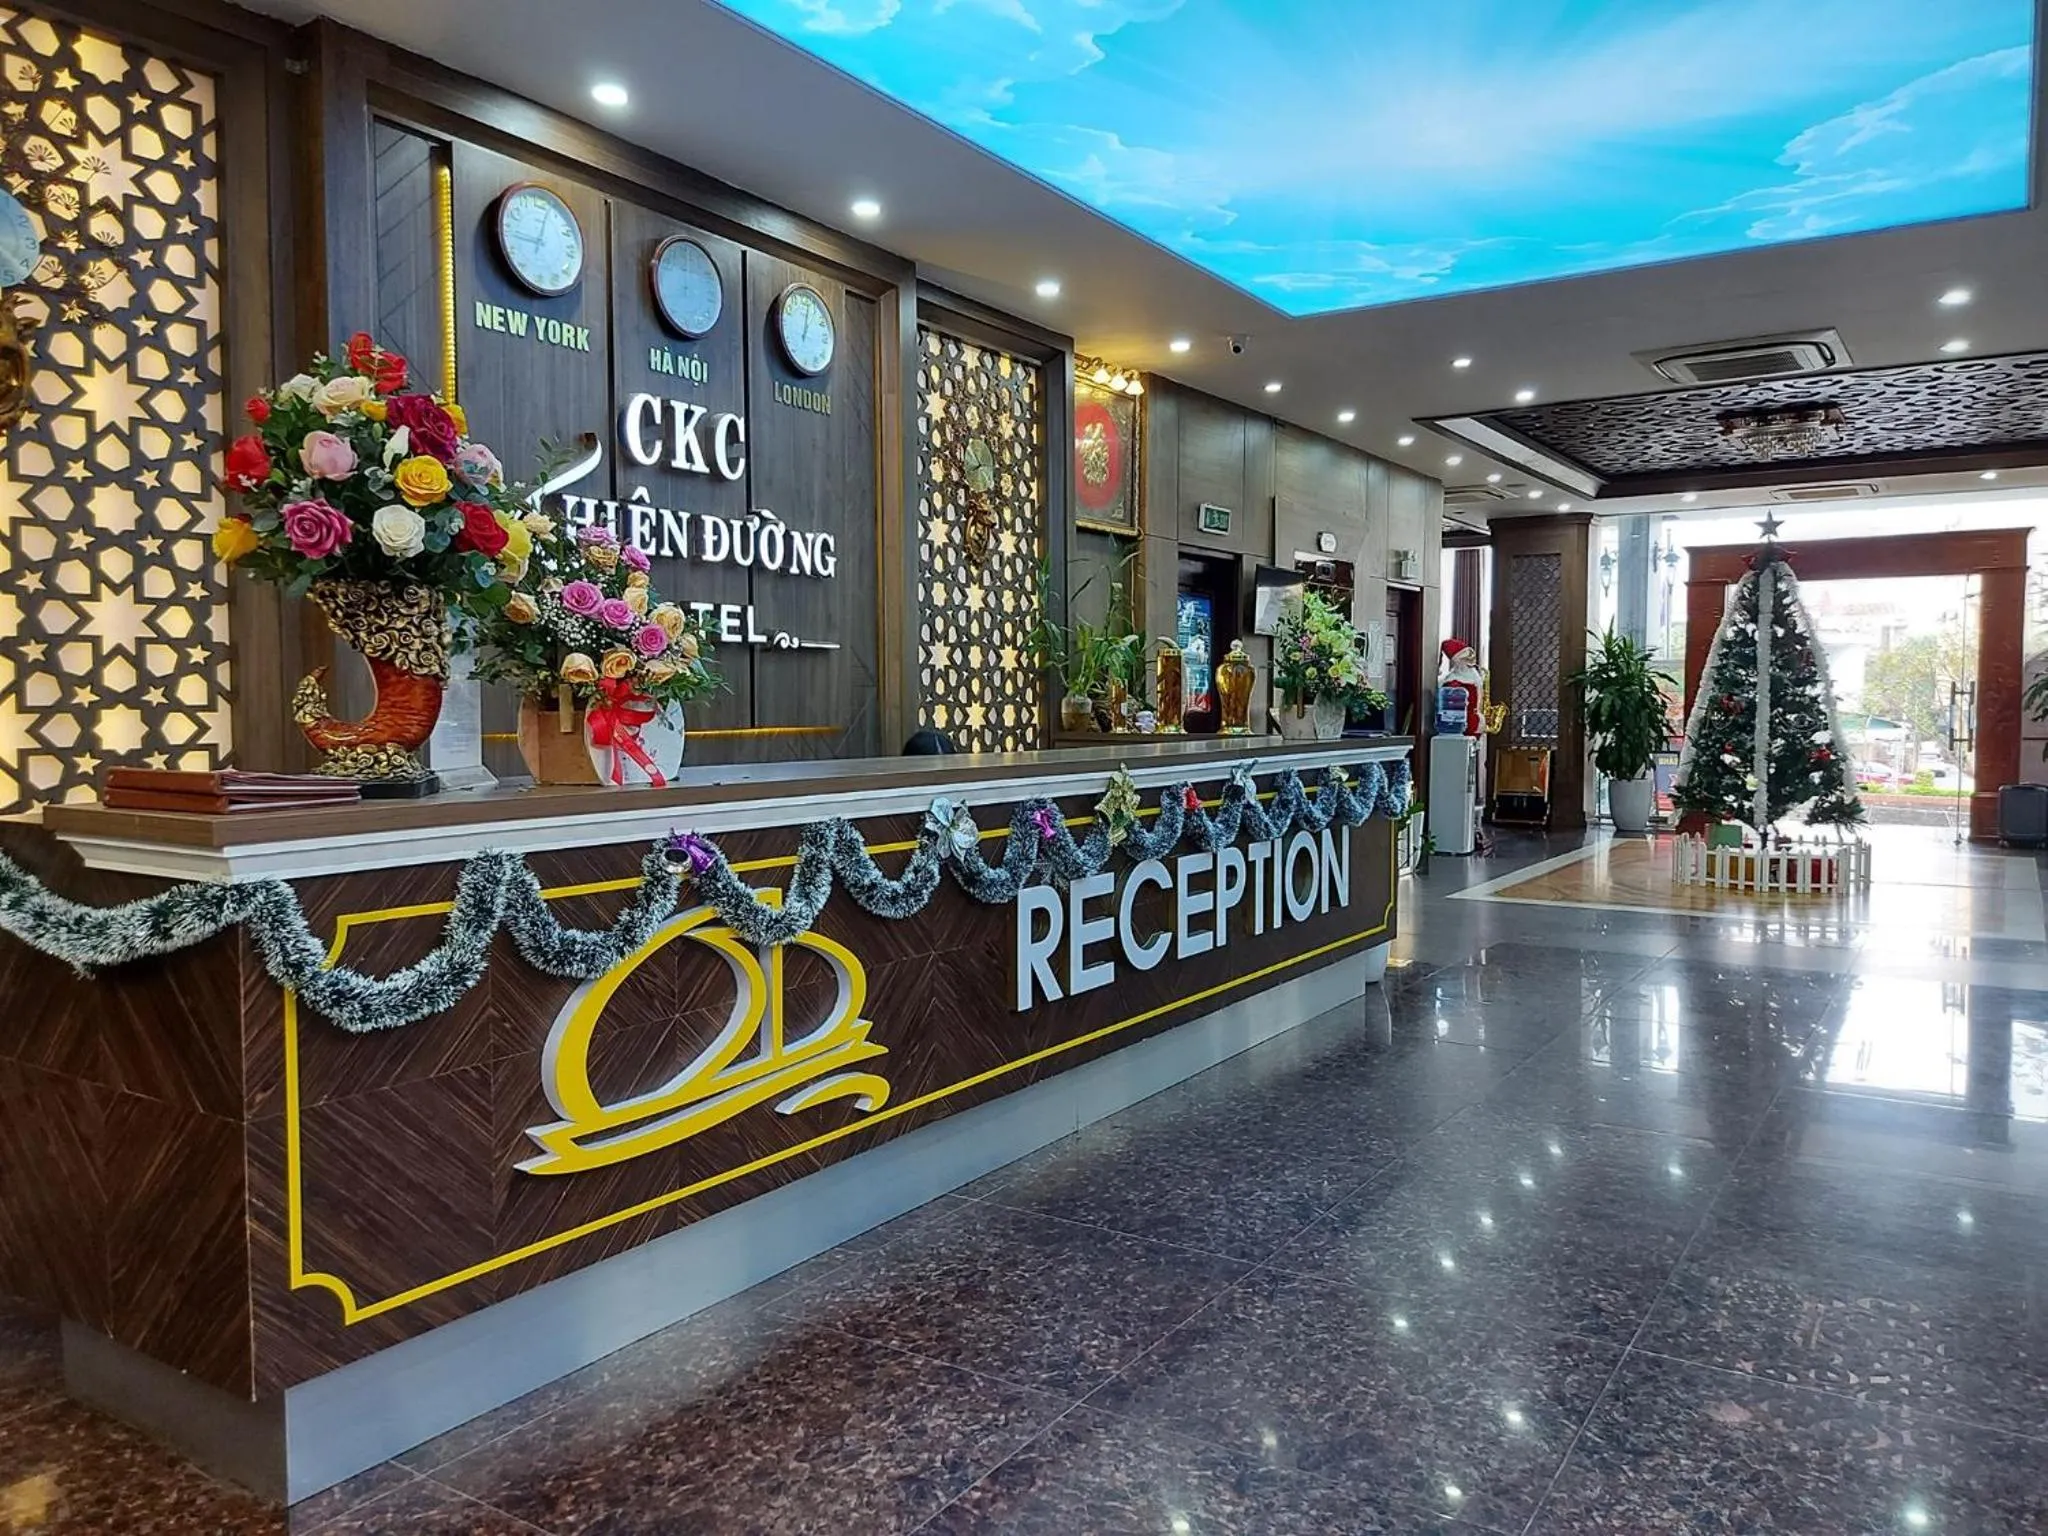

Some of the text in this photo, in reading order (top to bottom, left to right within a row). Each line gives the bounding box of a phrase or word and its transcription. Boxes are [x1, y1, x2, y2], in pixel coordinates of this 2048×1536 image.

[475, 301, 590, 352] NEW YORK
[650, 345, 709, 386] HÀ NỘI
[774, 381, 831, 415] LONDON
[625, 392, 746, 481] CKC
[530, 480, 837, 579] HIÊN ĐƯỜNG
[690, 601, 768, 644] TEL
[1016, 824, 1350, 1013] RECEPTION
